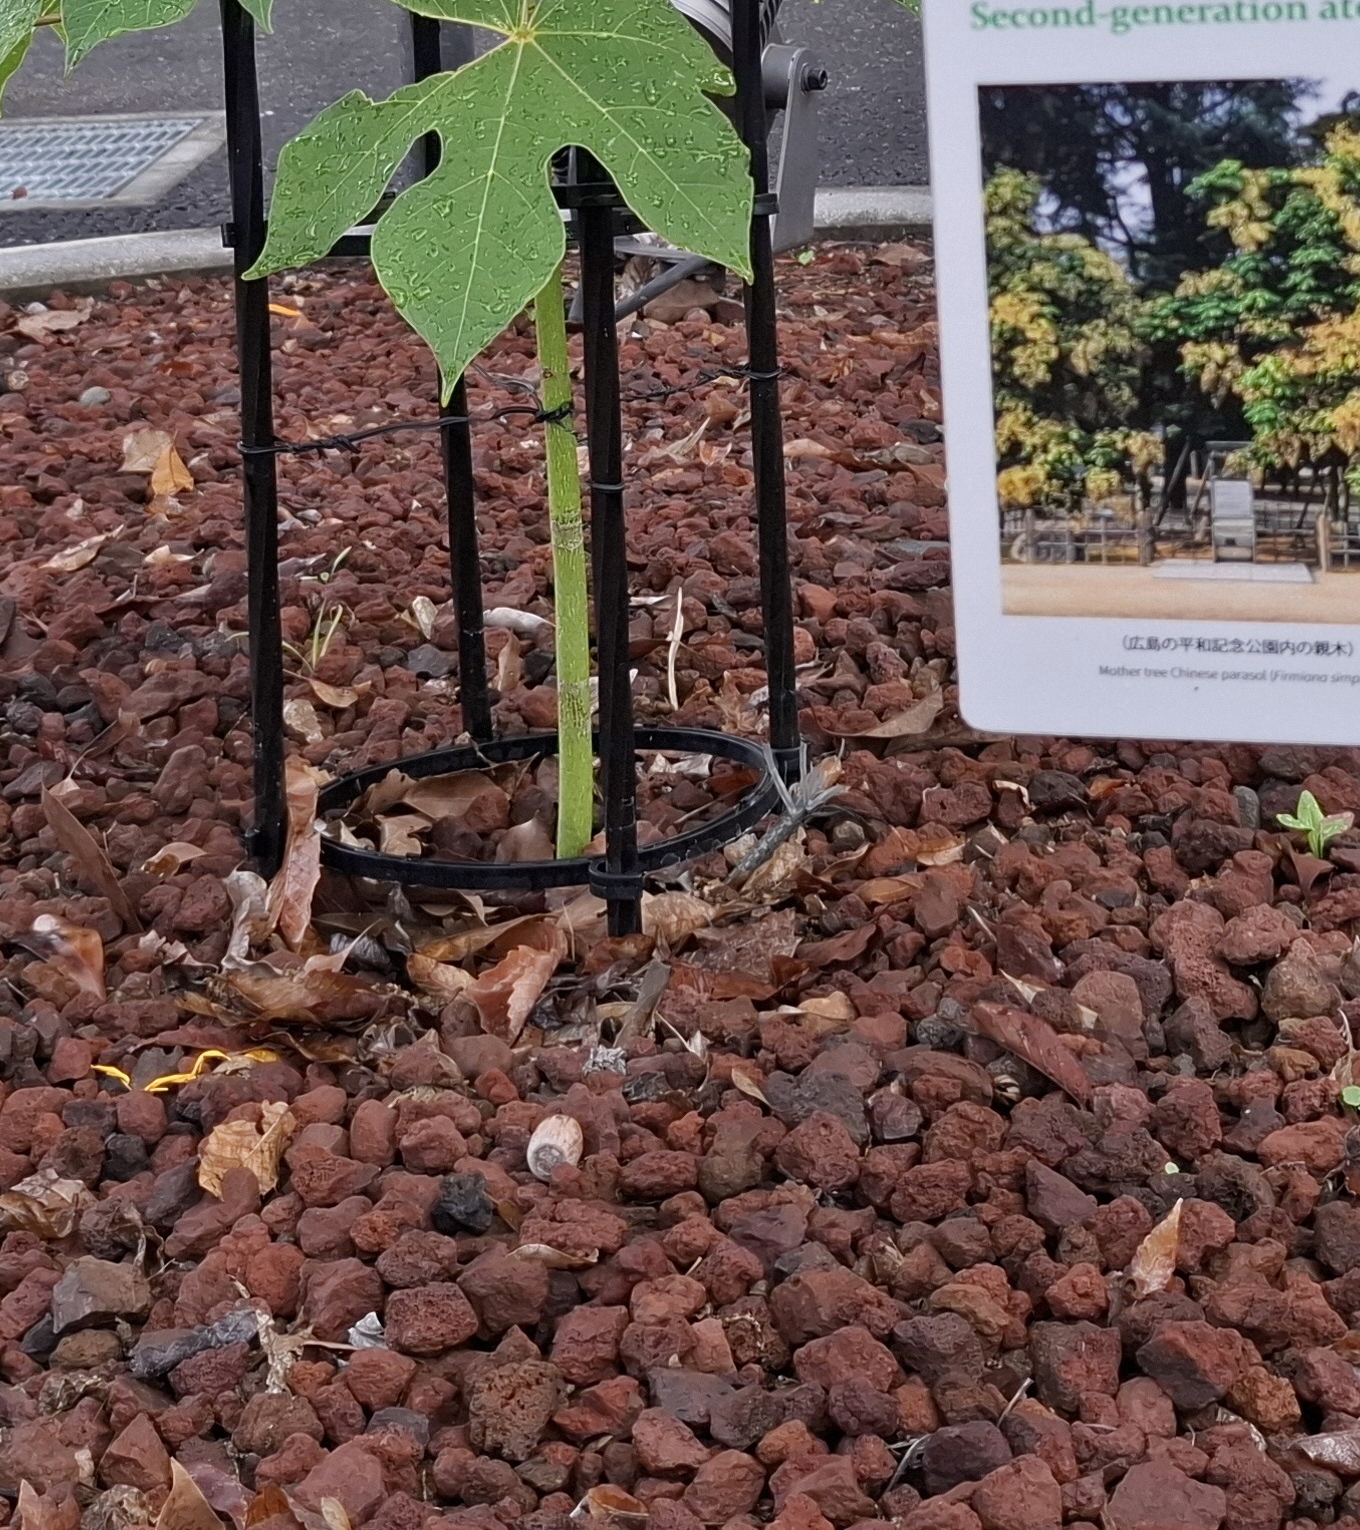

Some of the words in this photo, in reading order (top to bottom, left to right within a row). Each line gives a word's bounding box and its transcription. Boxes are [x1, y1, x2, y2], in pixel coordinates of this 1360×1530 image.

[1099, 664, 1141, 678] Mother
[1144, 666, 1167, 678] tree
[1170, 667, 1218, 680] Chinese
[1221, 668, 1267, 682] parasol
